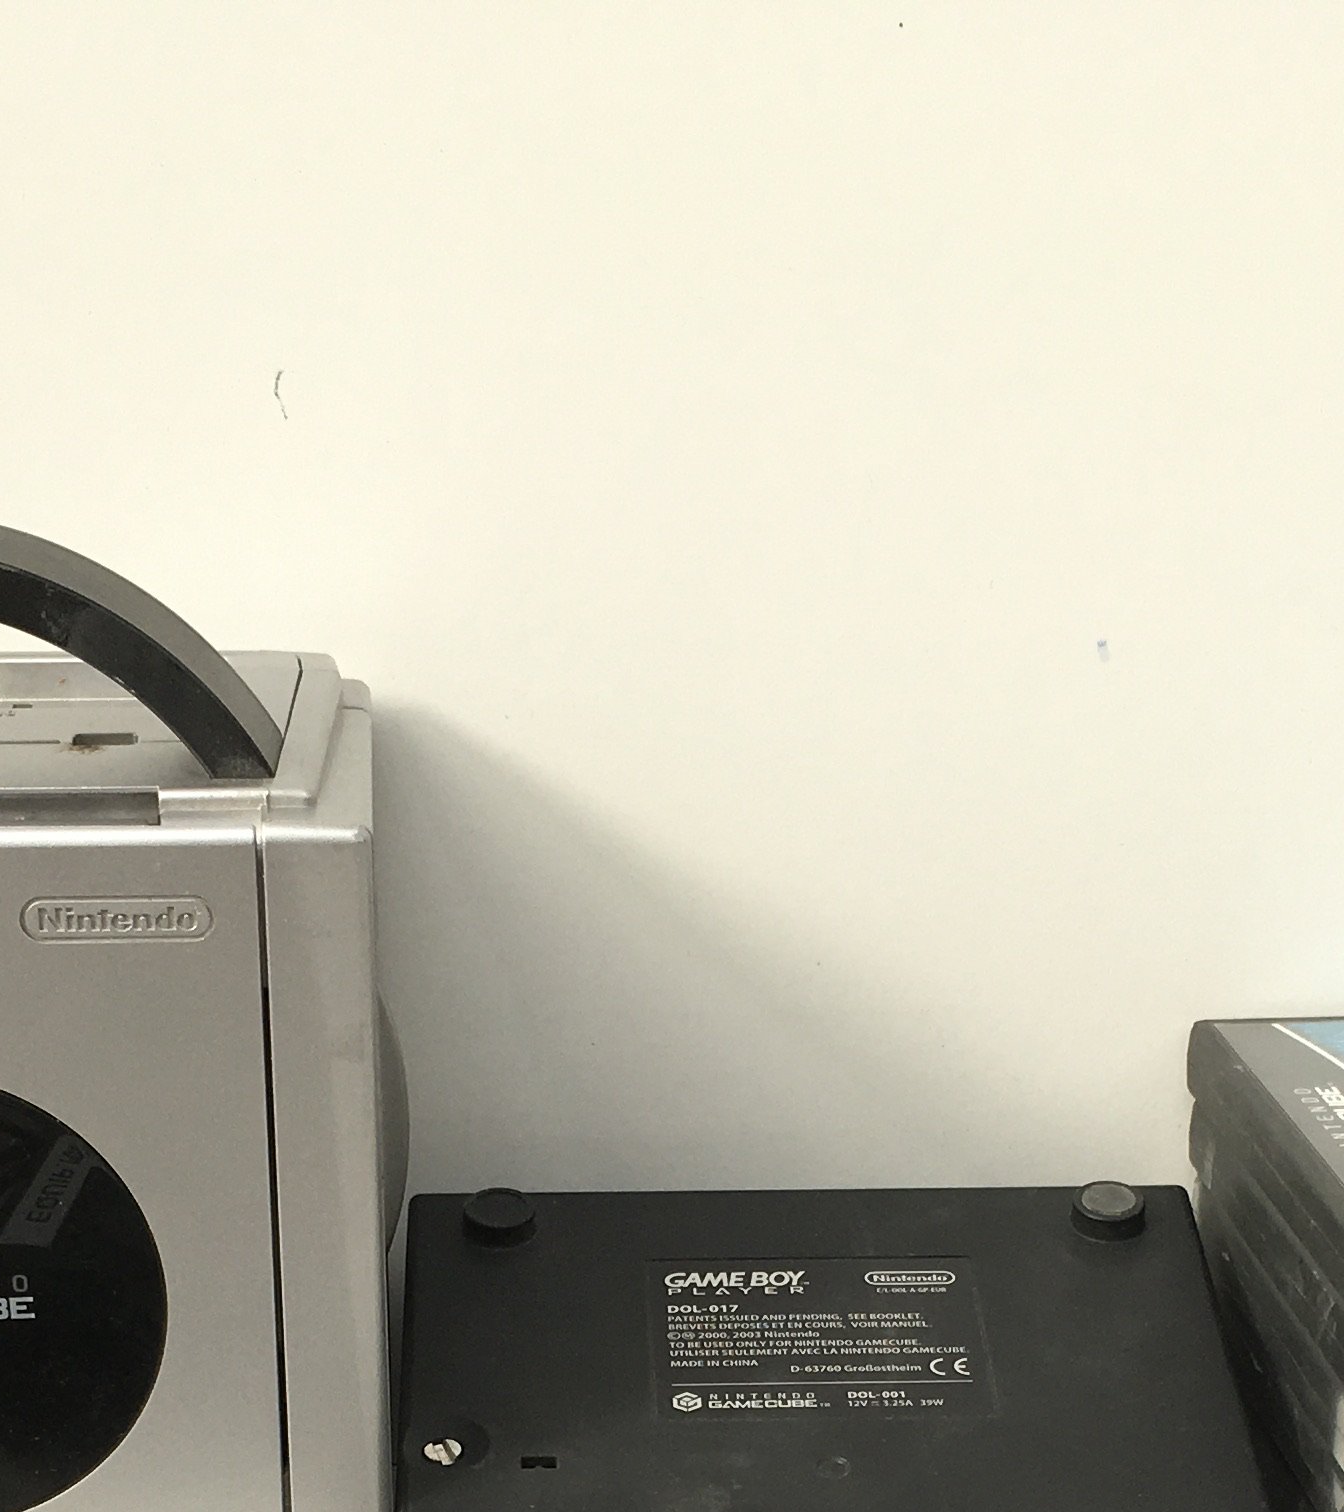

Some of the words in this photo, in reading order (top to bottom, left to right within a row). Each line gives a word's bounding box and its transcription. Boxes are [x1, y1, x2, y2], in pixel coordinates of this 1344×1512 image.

[37, 905, 198, 933] Nintendo
[664, 1271, 746, 1287] GAME
[872, 1274, 948, 1282] Nintendo
[667, 1286, 805, 1296] PLAYER
[667, 1304, 739, 1314] DOL-017
[719, 1314, 760, 1322] ISSUED
[668, 1323, 717, 1331] BREVETS
[732, 1331, 762, 1339] 2003
[669, 1341, 685, 1349] TO
[703, 1340, 734, 1348] USED
[794, 1339, 854, 1347] NINTENDO
[669, 1349, 719, 1357] UTILISER
[721, 1348, 788, 1356] SEULEMENT
[840, 1347, 904, 1355] NINTENDO
[722, 1359, 759, 1367] CHINA
[790, 1364, 842, 1373] D-63760
[709, 1392, 816, 1400] NINTENDO
[847, 1391, 906, 1399] DOL-001
